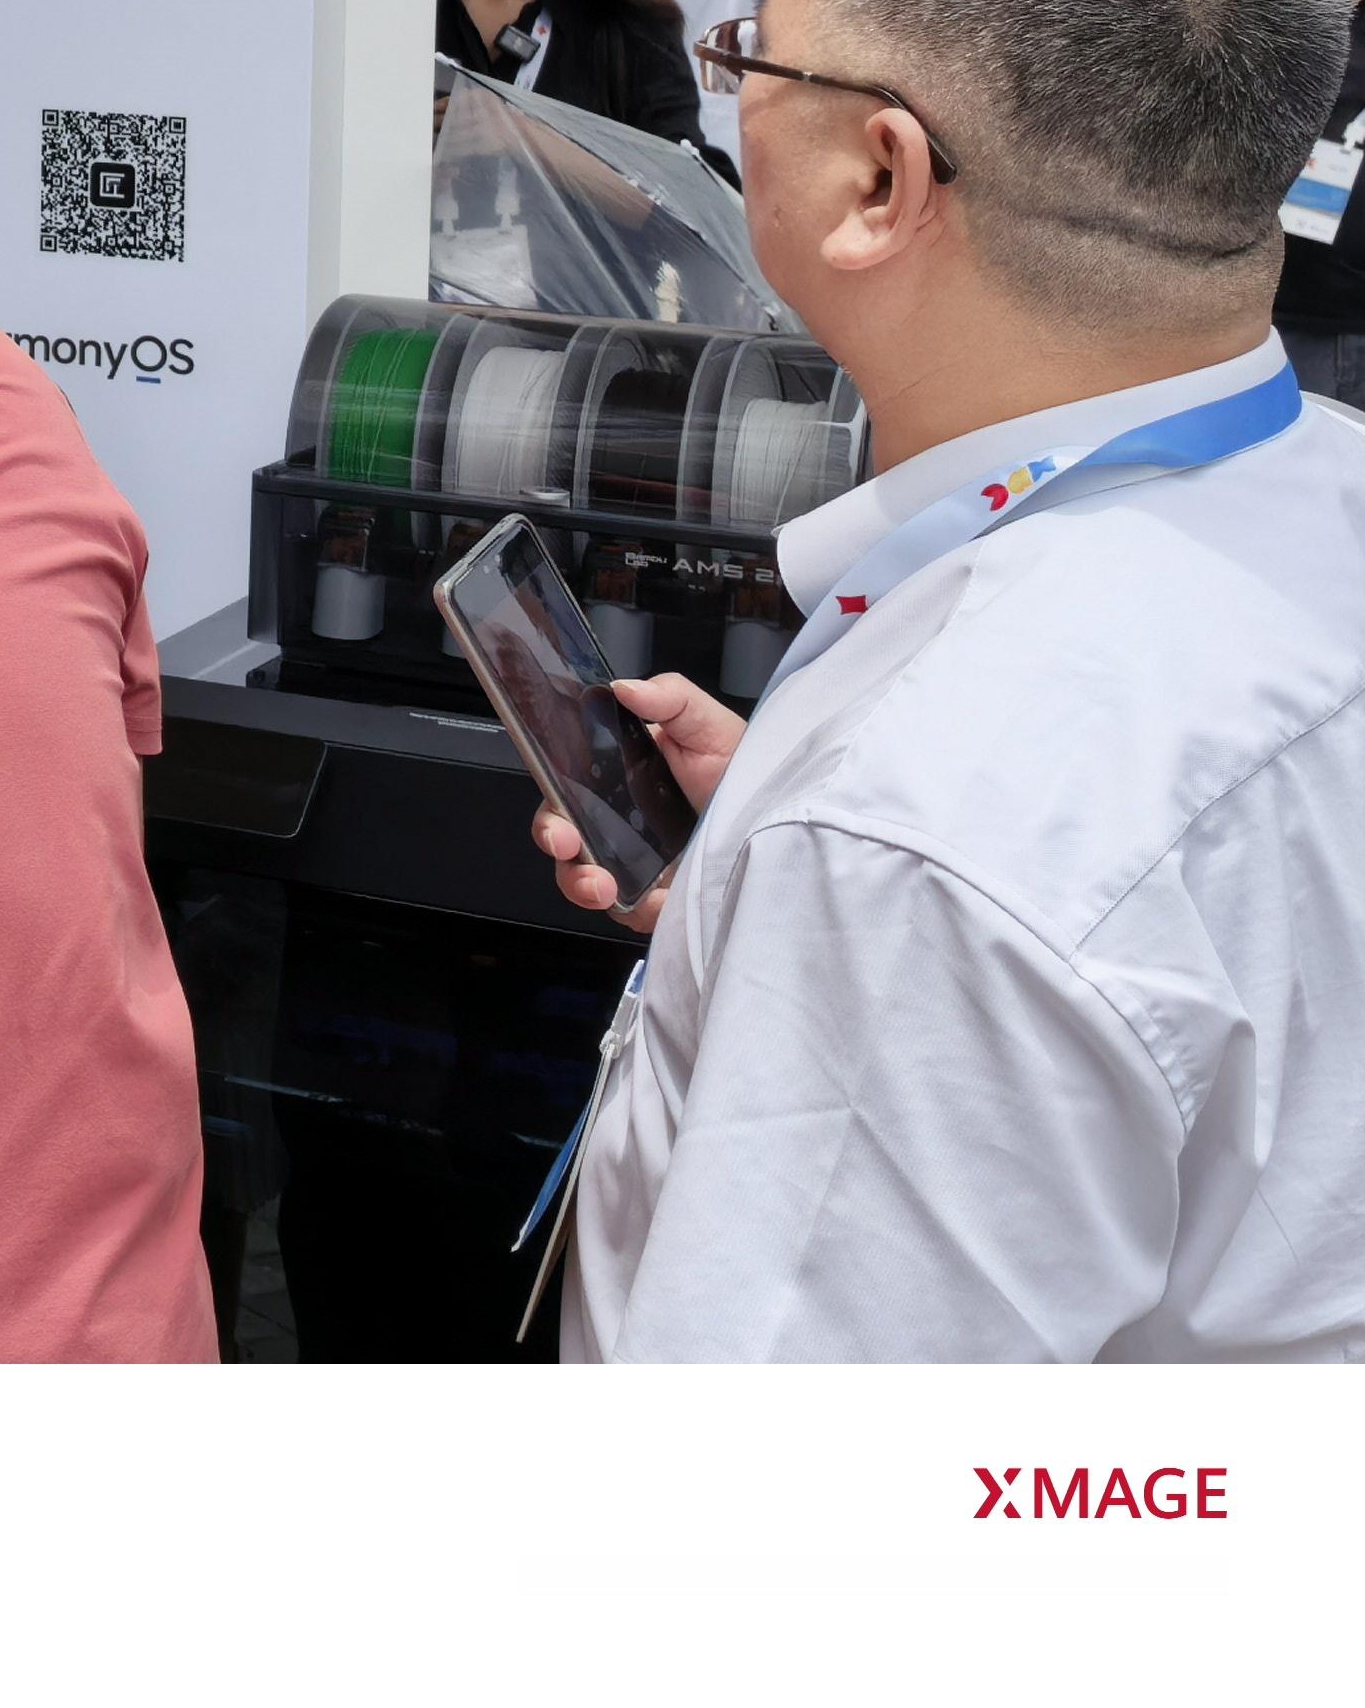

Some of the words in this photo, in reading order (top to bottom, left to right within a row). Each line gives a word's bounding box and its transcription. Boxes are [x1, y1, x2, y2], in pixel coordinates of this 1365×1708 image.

[6, 332, 195, 382] monyOS
[672, 558, 744, 580] AMS
[755, 567, 775, 583] 2
